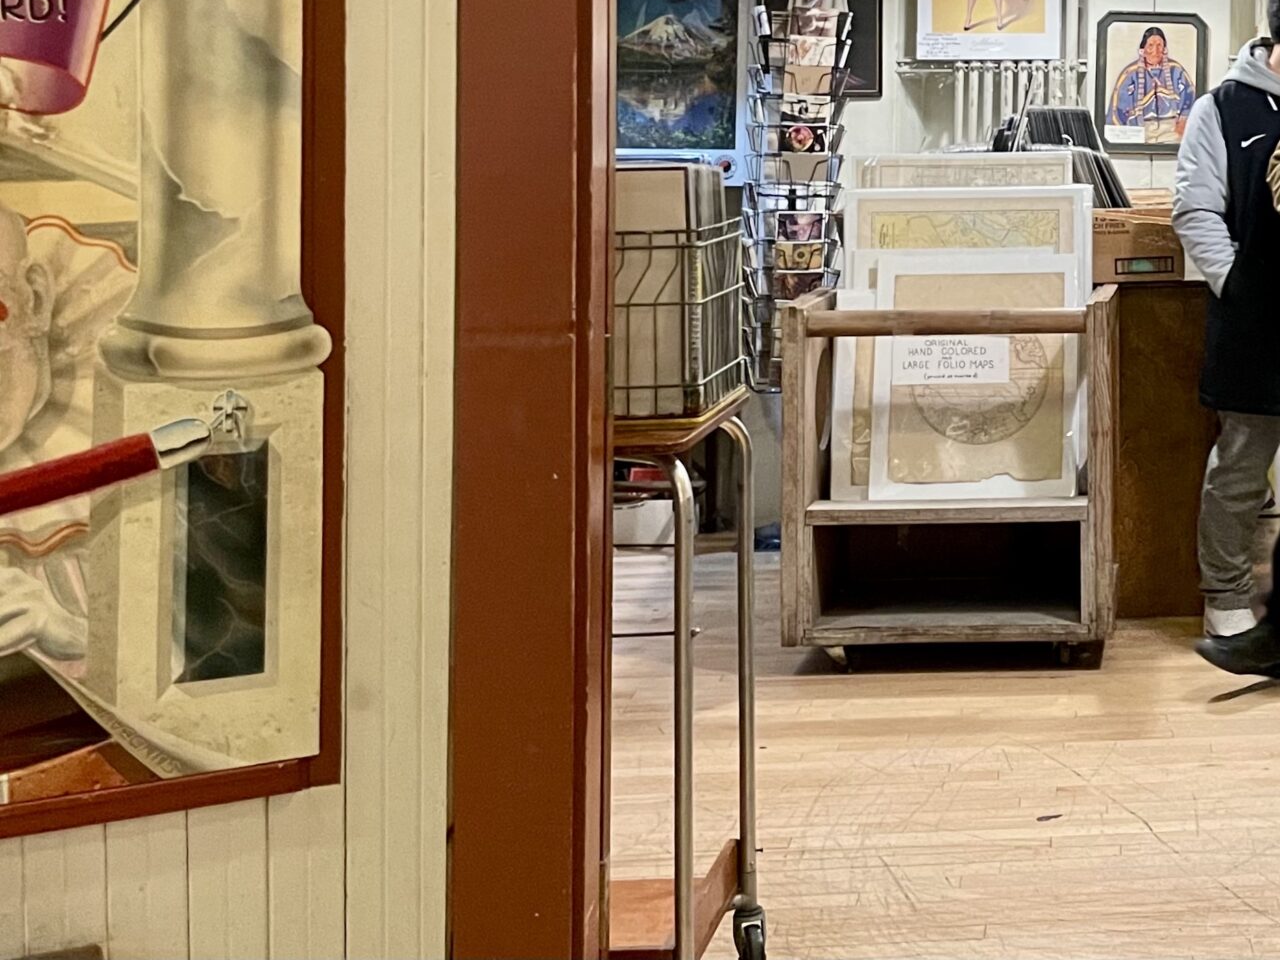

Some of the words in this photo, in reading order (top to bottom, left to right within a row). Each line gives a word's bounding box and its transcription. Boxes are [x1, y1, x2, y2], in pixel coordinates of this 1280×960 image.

[908, 347, 933, 356] HAND
[941, 346, 987, 356] COLORED
[902, 360, 929, 370] LARGE
[937, 360, 965, 369] FOLIO
[969, 359, 995, 369] MAPS
